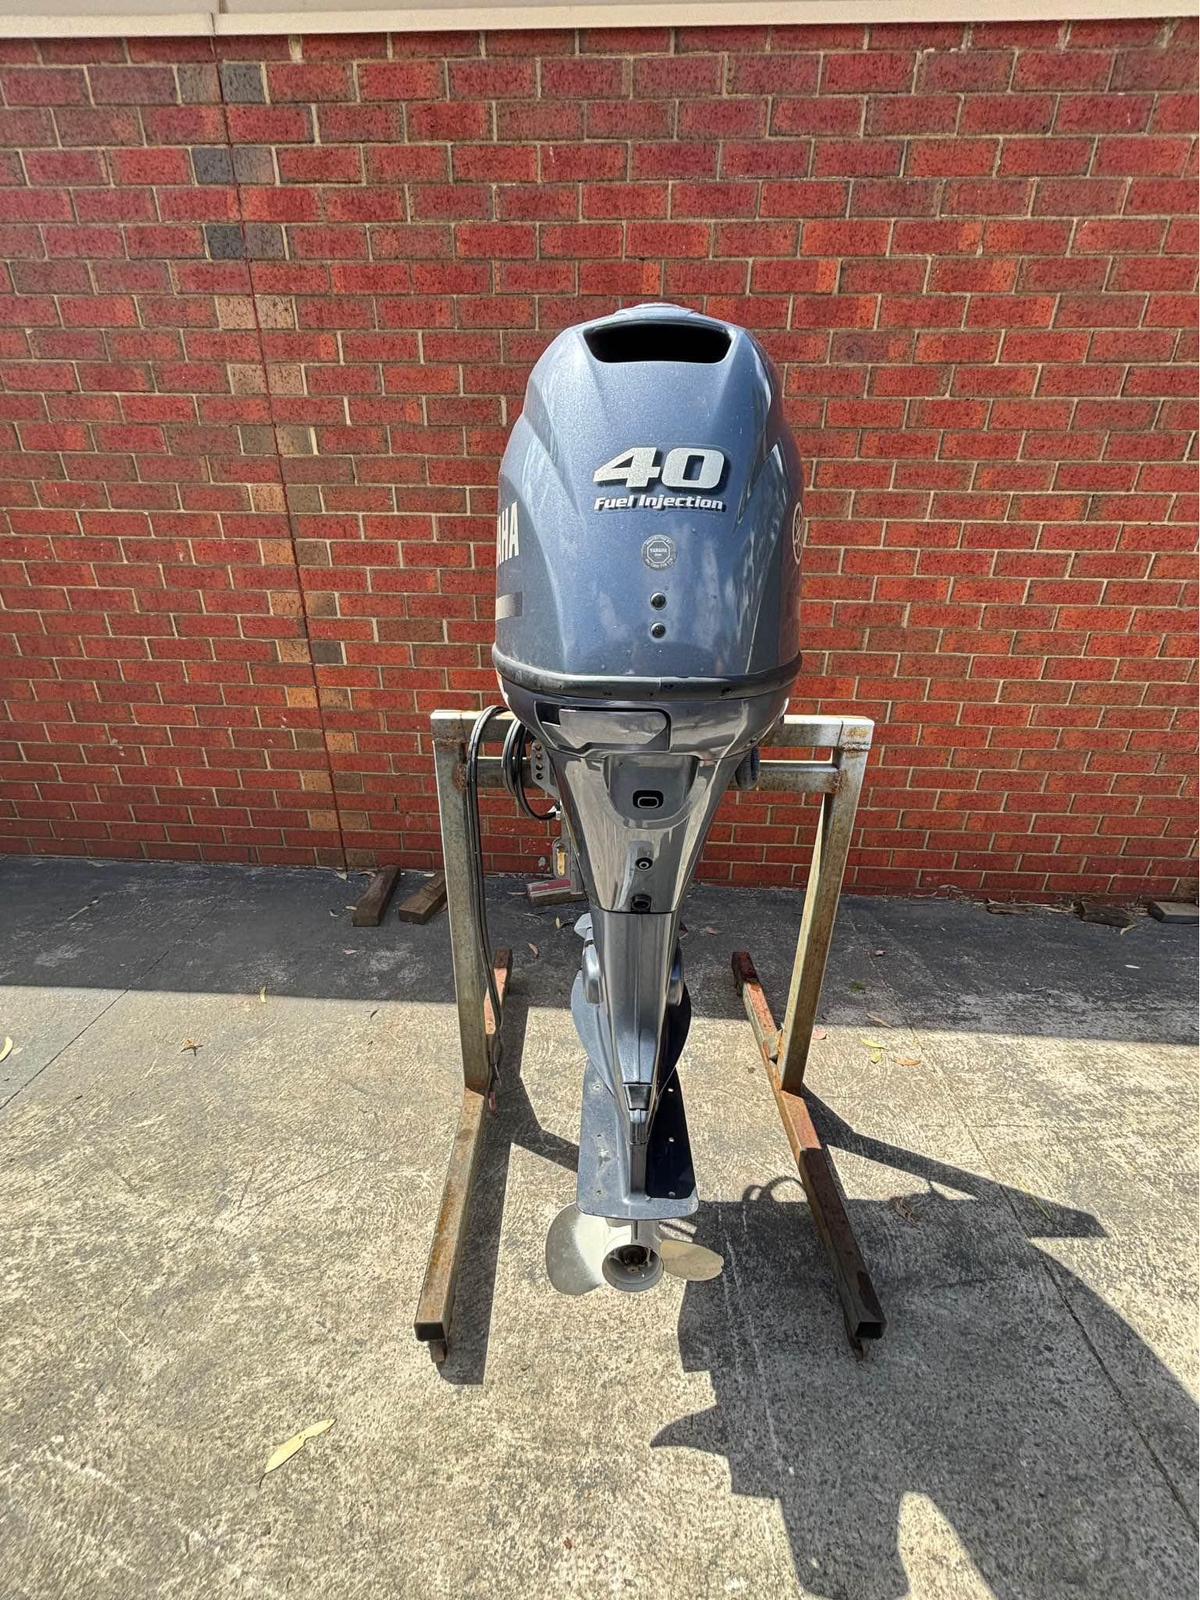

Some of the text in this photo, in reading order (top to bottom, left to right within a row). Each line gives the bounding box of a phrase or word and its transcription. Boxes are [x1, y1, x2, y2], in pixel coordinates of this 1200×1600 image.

[593, 447, 725, 489] 40
[593, 494, 724, 511] Fuel Injection
